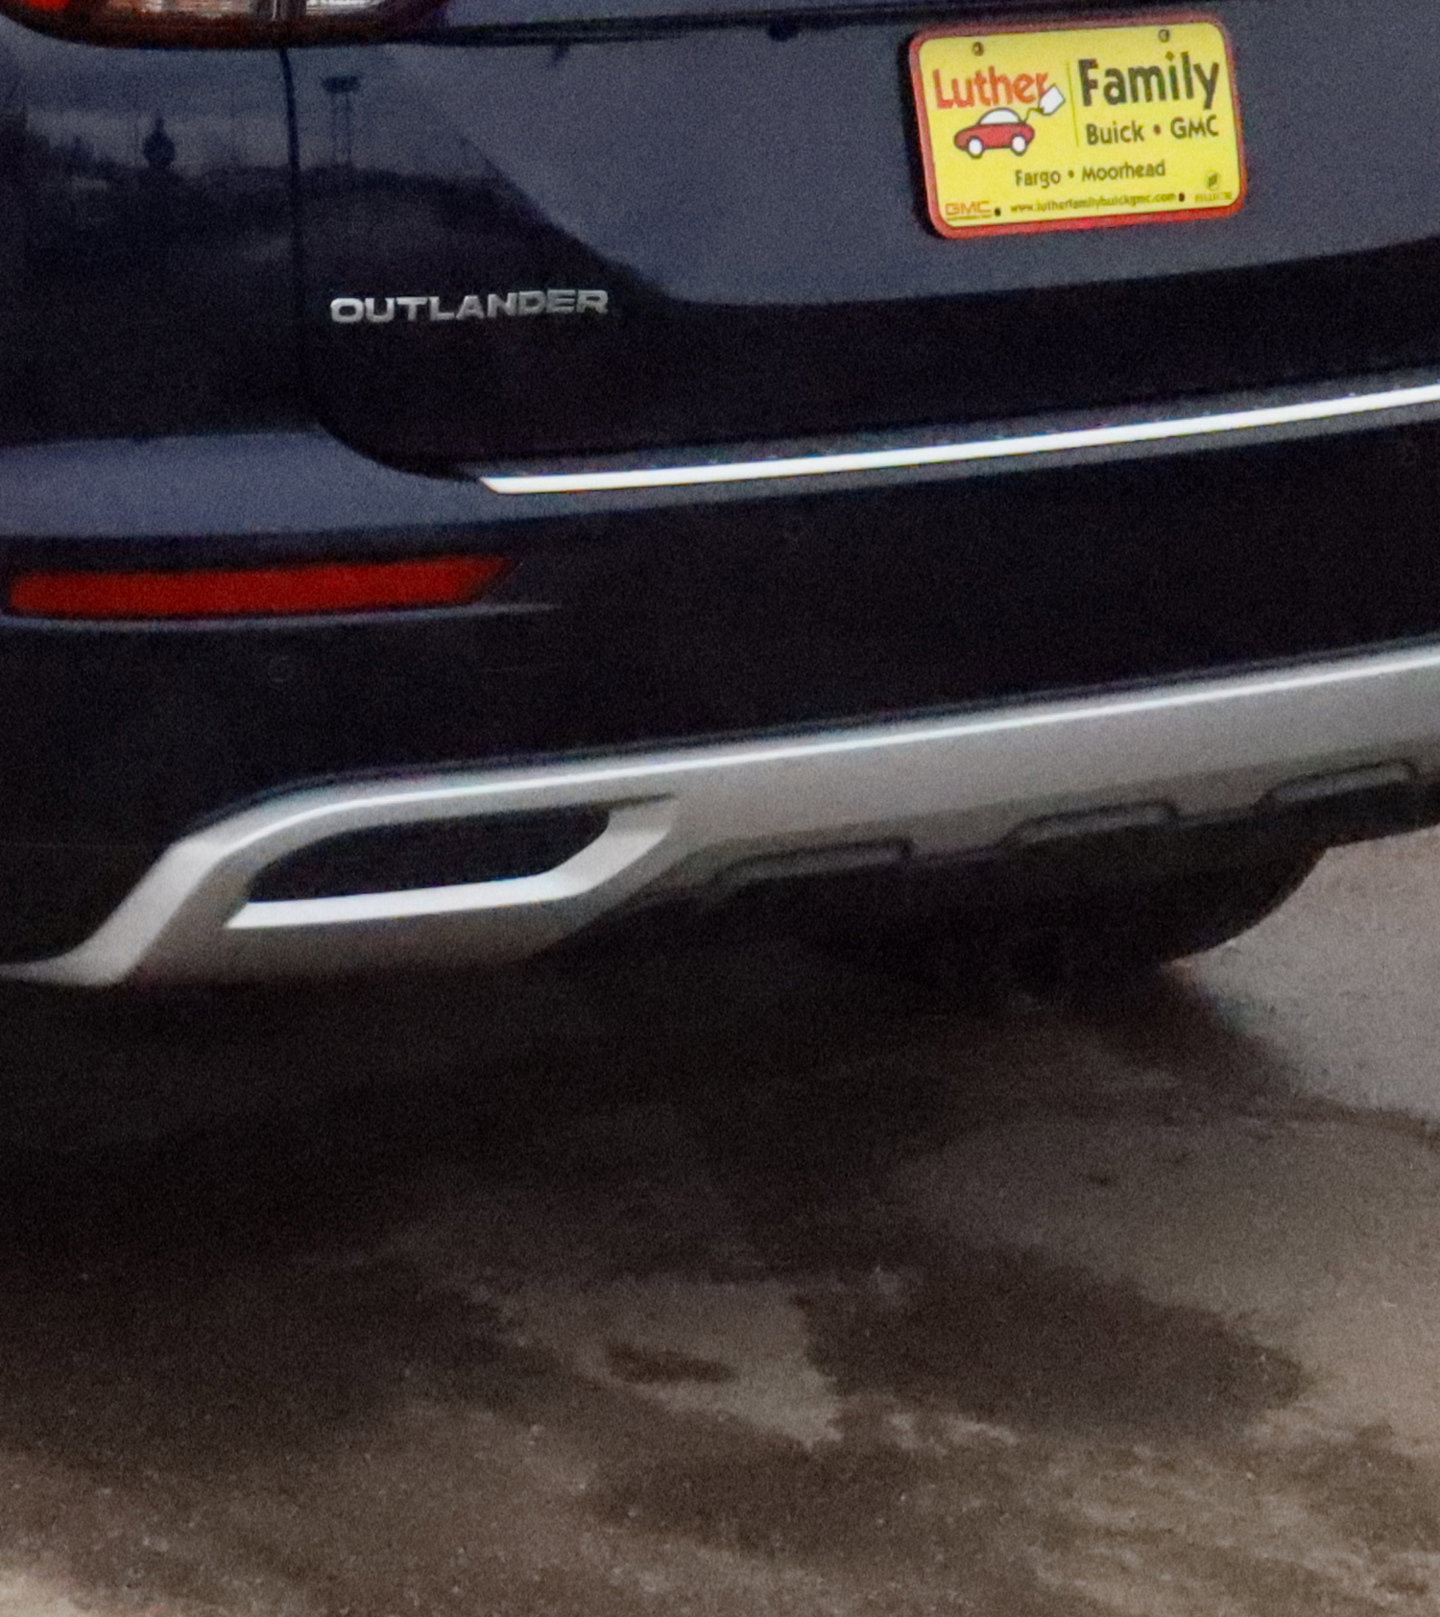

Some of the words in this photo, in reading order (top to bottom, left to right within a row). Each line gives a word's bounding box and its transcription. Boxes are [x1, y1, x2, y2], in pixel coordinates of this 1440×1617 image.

[932, 65, 1049, 109] Luther
[1078, 50, 1220, 110] Family
[1086, 119, 1144, 145] Buick
[1170, 114, 1219, 139] GMC
[1015, 169, 1061, 188] Fargo
[1081, 159, 1166, 182] Moorhead
[945, 200, 992, 217] GMC
[329, 288, 609, 324] OUTLANDER
